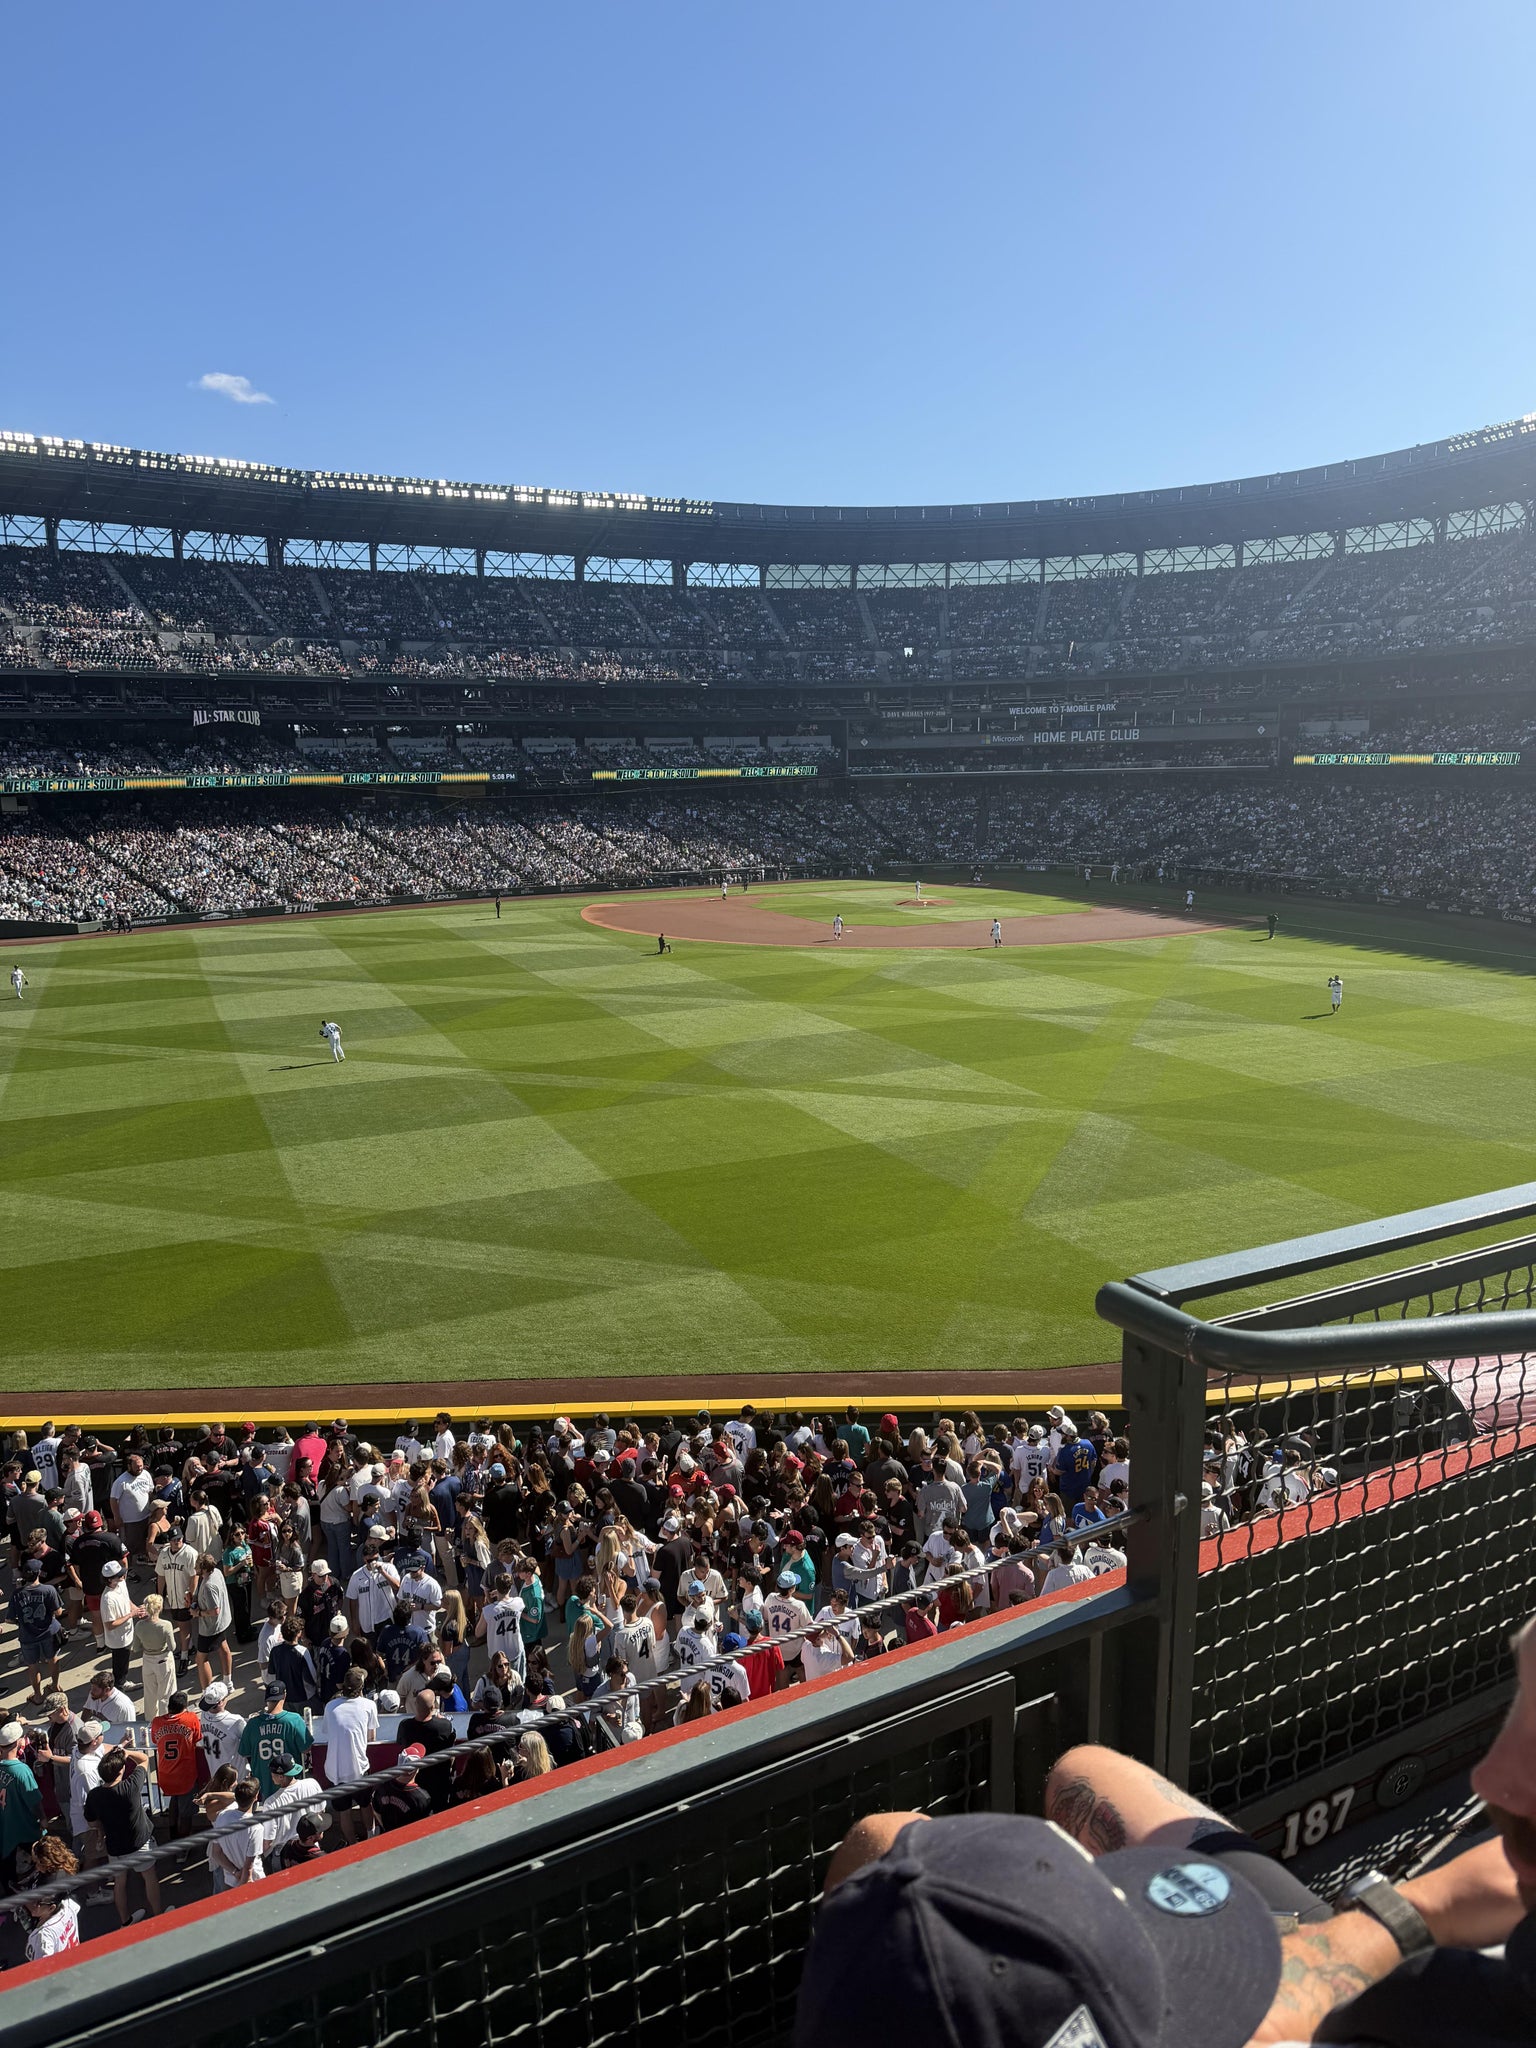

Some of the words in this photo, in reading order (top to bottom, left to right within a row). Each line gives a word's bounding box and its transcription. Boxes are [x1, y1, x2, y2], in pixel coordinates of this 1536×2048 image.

[1009, 706, 1047, 715] WELCOME
[1048, 706, 1059, 714] TO
[1060, 704, 1095, 714] T-MOBILE
[1096, 703, 1117, 712] PARK
[237, 710, 261, 726] CLUB
[992, 735, 1025, 743] Microsoft
[1033, 731, 1066, 743] HOME
[1070, 730, 1106, 742] PLATE
[1110, 729, 1140, 741] CLUB
[1357, 753, 1369, 764] THE
[1369, 753, 1391, 764] SOUND
[1467, 753, 1479, 765] TO
[1480, 753, 1496, 764] THE
[384, 773, 396, 784] TO
[397, 773, 414, 783] THE
[414, 772, 442, 783] SOUND
[662, 769, 676, 779] THE
[676, 768, 699, 779] SOUND
[784, 766, 797, 776] THE
[56, 779, 70, 792] TO
[73, 779, 91, 791] THE
[93, 778, 126, 790] SOUND
[231, 775, 243, 787] TO
[245, 775, 261, 787] THE
[262, 774, 291, 786] SOUND
[285, 902, 318, 914] STIHL
[354, 898, 374, 907] Great
[374, 897, 391, 906] Clips
[35, 1453, 54, 1470] 29
[1075, 1456, 1089, 1473] 24
[1028, 1462, 1042, 1477] 51
[163, 1562, 184, 1572] SEATTLE
[22, 1602, 46, 1624] 24
[496, 1617, 518, 1637] 44
[771, 1614, 792, 1633] 44
[638, 1637, 650, 1660] 4
[391, 1647, 412, 1666] 44
[680, 1646, 695, 1666] 44
[259, 1723, 284, 1737] WARD
[164, 1740, 180, 1760] 5
[202, 1735, 222, 1760] 44
[258, 1738, 285, 1761] 69
[1280, 1786, 1356, 1859] 187
